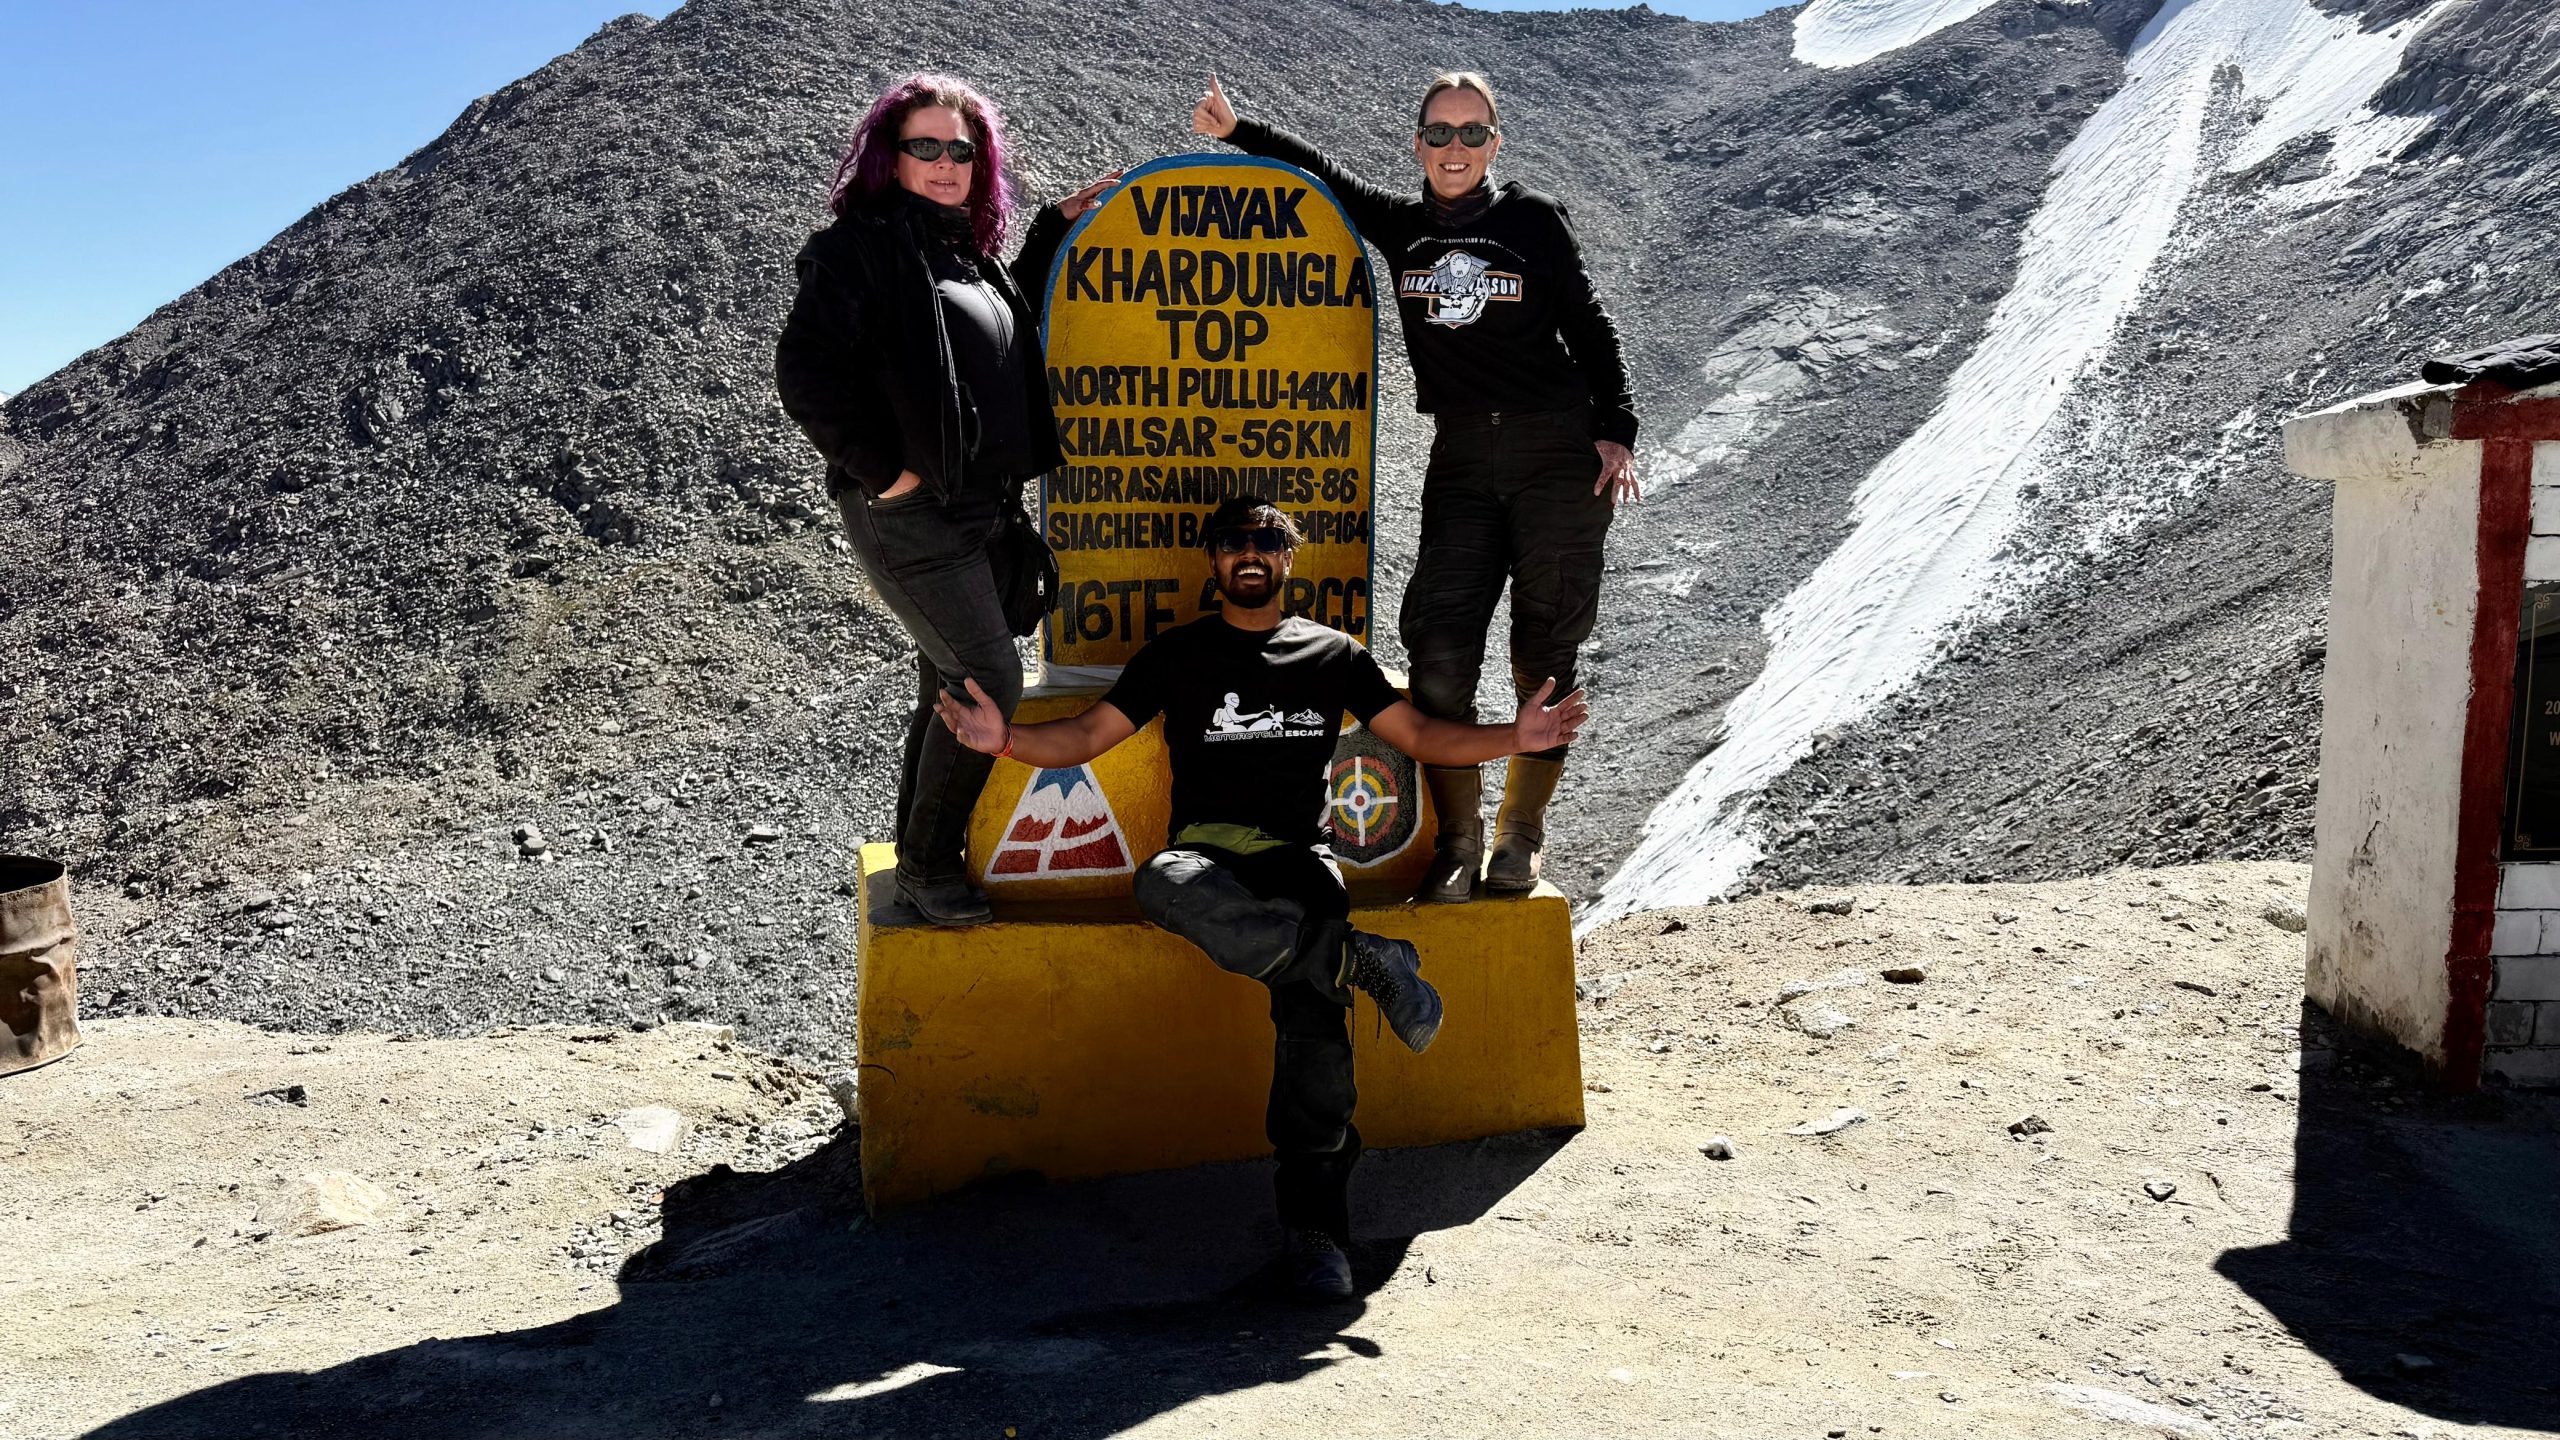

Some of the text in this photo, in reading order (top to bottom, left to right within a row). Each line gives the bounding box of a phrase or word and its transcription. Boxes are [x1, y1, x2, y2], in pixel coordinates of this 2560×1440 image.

[1130, 185, 1309, 240] VIJAYAK
[1066, 245, 1373, 308] KHARDUNGLA
[1156, 309, 1269, 362] TOP
[1047, 365, 1368, 411] NORTH PULLU-14KM
[1048, 510, 1174, 551] SIACHEN
[1283, 576, 1367, 635] RCC
[1203, 729, 1325, 743] MOTORCYCLE ESCAPE
